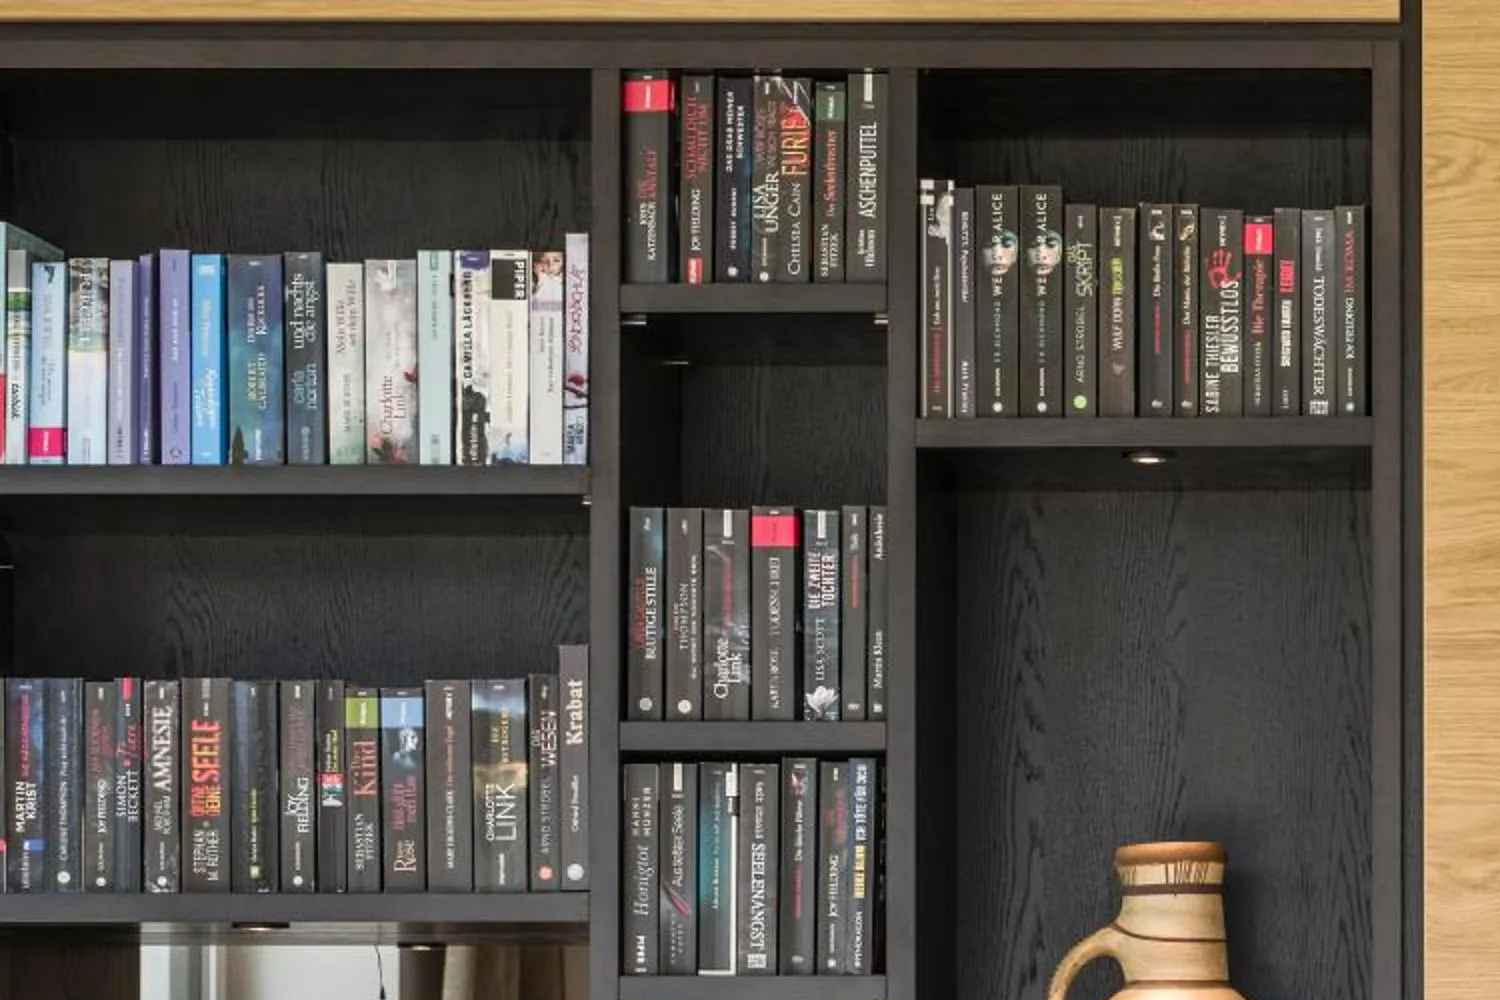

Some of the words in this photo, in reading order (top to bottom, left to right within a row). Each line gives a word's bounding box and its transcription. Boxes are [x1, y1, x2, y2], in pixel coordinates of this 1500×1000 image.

[859, 122, 877, 217] ASCHENPUTTEL
[765, 172, 779, 232] UNGER
[992, 193, 1002, 231] ALICE
[1037, 193, 1046, 231] ALICE
[1077, 242, 1092, 296] SKRIPT
[1222, 280, 1239, 372] BEWUSSTLOS
[379, 375, 393, 434] Charlotte
[645, 567, 657, 606] STILLE
[823, 554, 835, 606] TOCHTER
[645, 608, 657, 659] BLUTIGE
[680, 583, 688, 650] THOMPSON
[714, 638, 728, 698] Charlotte
[728, 652, 742, 682] Link
[541, 711, 556, 766] WESEN
[566, 680, 583, 744] Krabat
[153, 706, 173, 791] AMNESIE
[192, 719, 219, 782] SEELE
[353, 739, 377, 796] Kind
[16, 781, 25, 832] MARTIN
[26, 781, 36, 819] KRIST
[117, 775, 126, 816] SIMON
[127, 770, 138, 822] BECKETT
[497, 783, 516, 841] LINK
[634, 845, 654, 915] Honigtot
[752, 843, 764, 948] SEELENANGST
